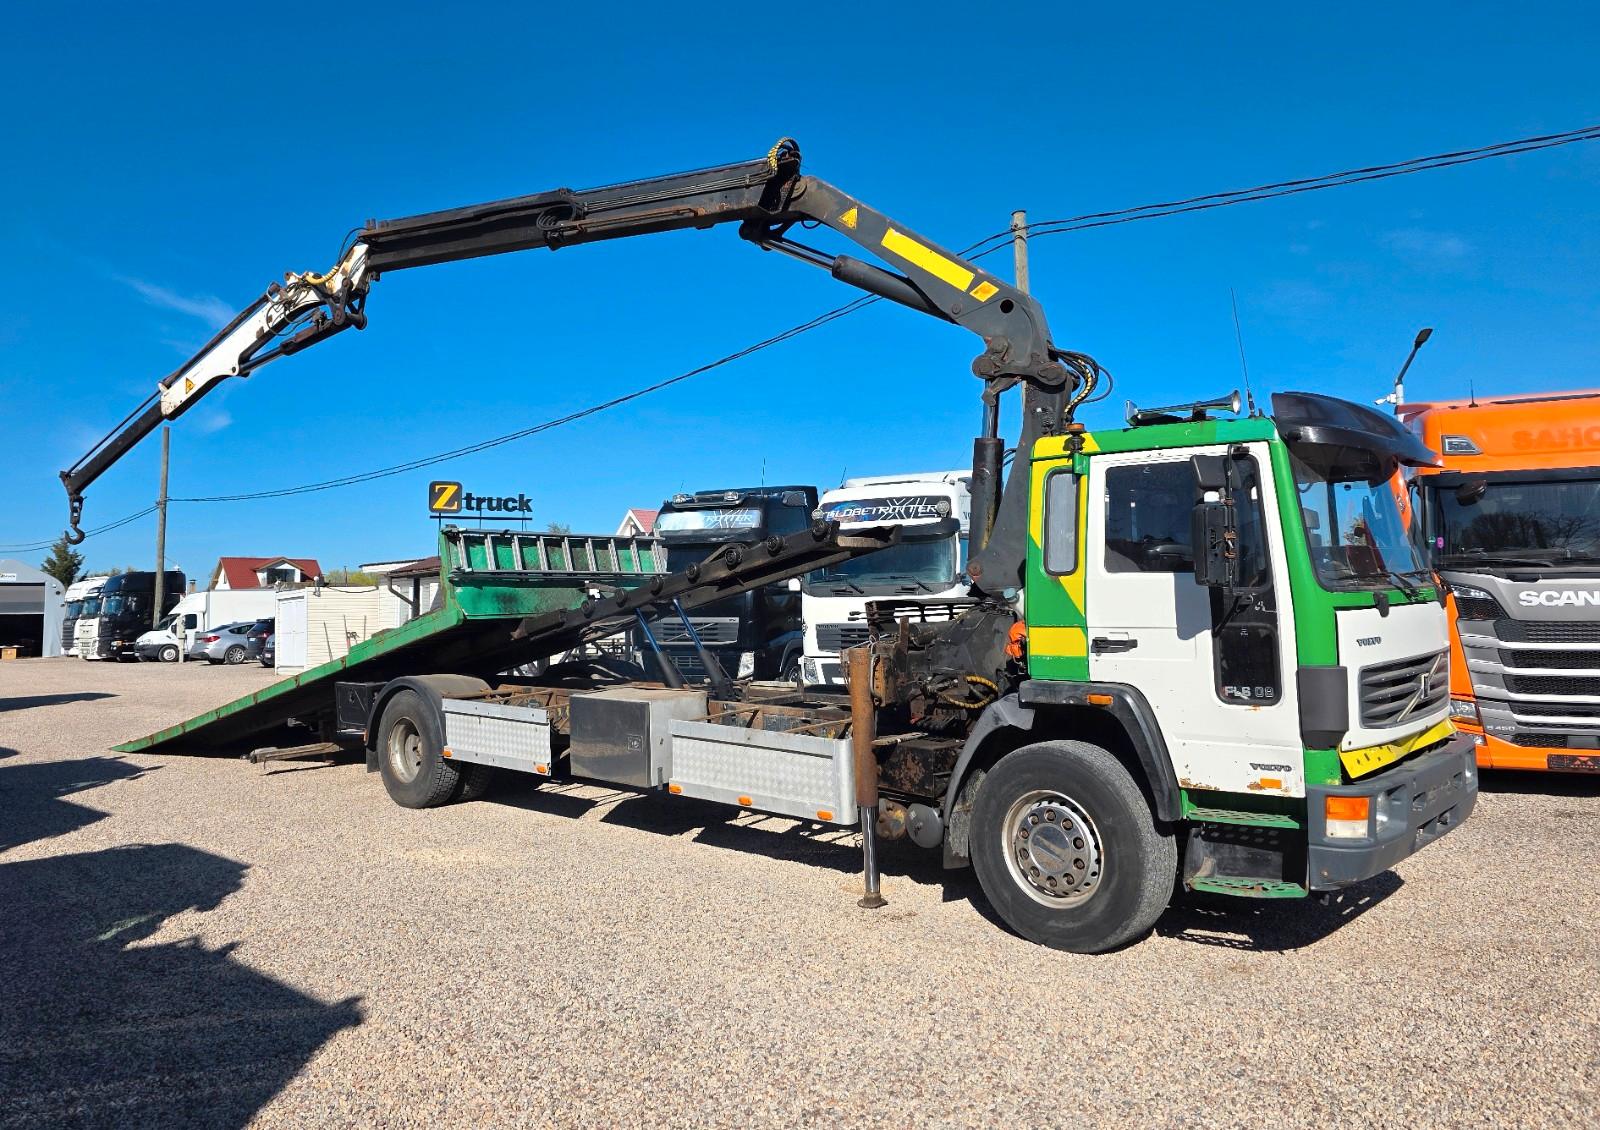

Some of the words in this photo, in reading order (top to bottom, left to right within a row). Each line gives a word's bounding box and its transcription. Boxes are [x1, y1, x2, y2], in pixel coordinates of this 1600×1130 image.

[432, 484, 458, 510] Z
[463, 492, 533, 513] truck
[1356, 636, 1382, 647] VOLVO
[1249, 762, 1292, 773] VOLVO
